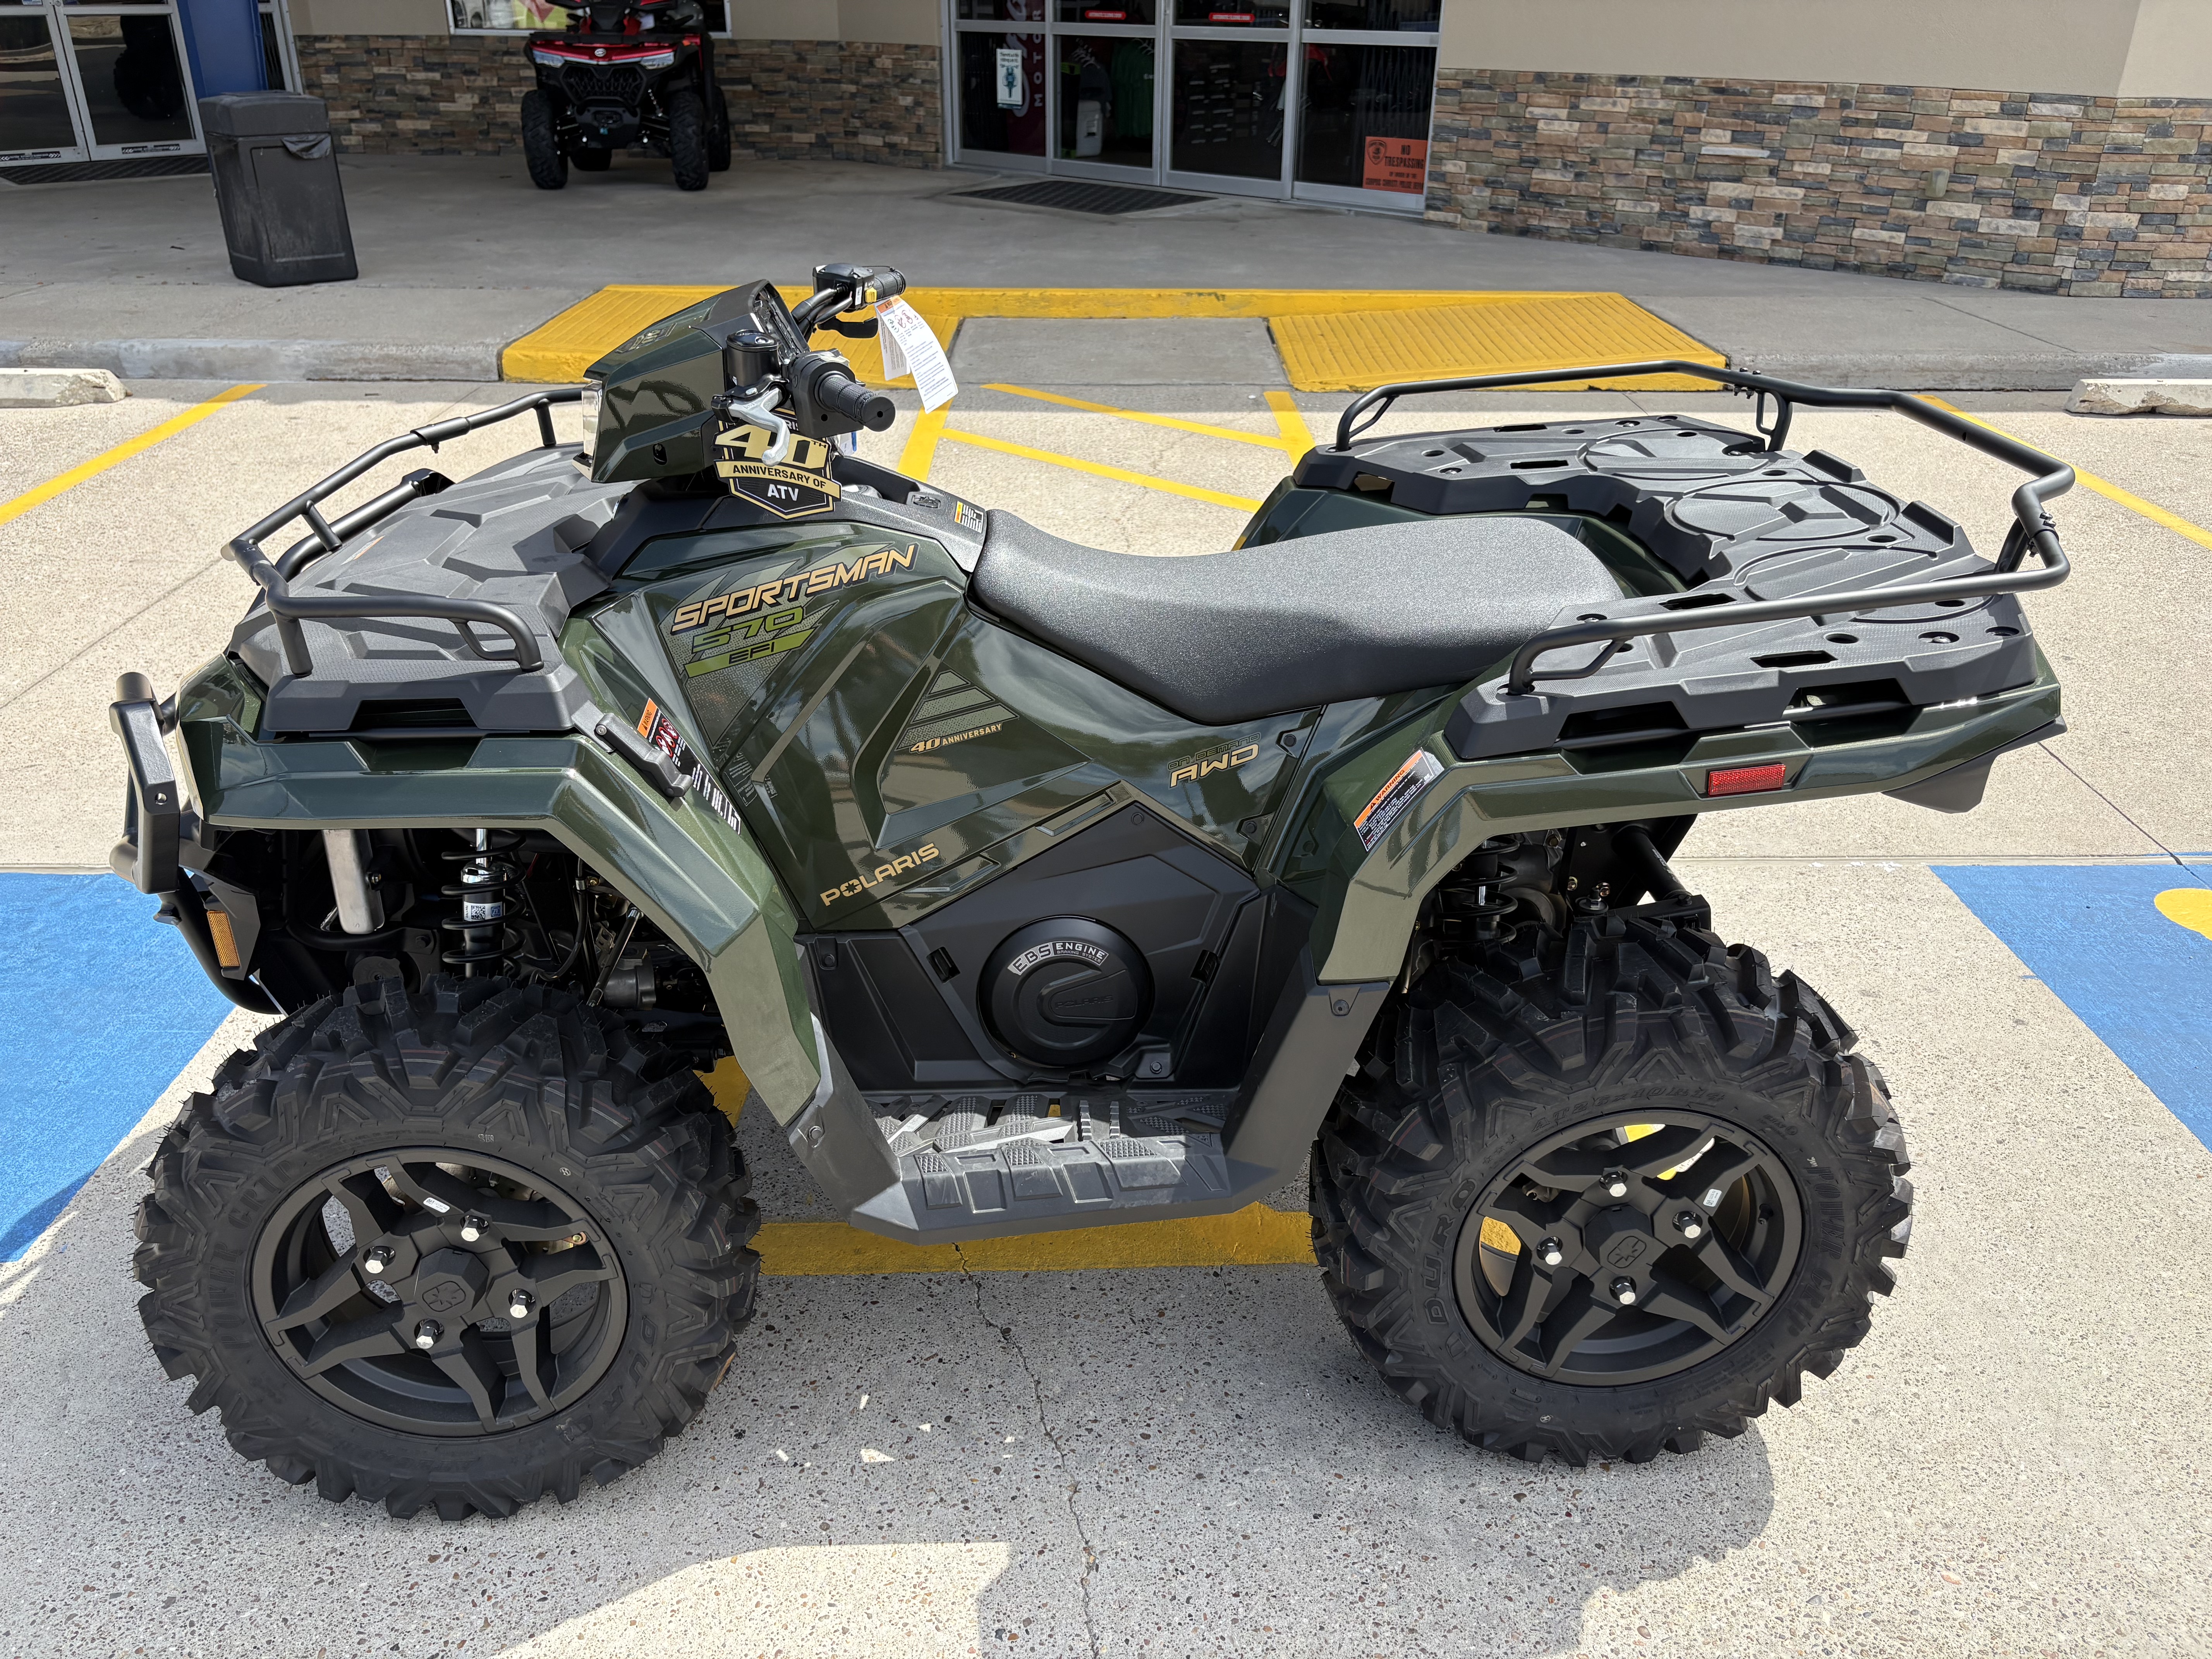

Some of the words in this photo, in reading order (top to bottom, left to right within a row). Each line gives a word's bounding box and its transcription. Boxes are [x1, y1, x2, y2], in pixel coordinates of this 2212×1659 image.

[1385, 156, 1424, 169] TRESPASSING
[733, 465, 810, 484] ANNIVERSARY
[813, 479, 826, 489] OF
[767, 484, 799, 501] ATV
[672, 544, 917, 633] SPORTSMAN
[692, 608, 804, 653] 570
[729, 641, 775, 665] EFI
[644, 709, 653, 725] WARNING
[942, 723, 1003, 746] ANNIVERSARY
[1196, 733, 1260, 759] DEMAND
[1170, 743, 1259, 788] AWD
[1376, 769, 1405, 801] WARNING
[819, 842, 940, 907] POLARIS
[1012, 944, 1052, 973] EBS
[1056, 943, 1105, 959] ENGINE
[1082, 953, 1101, 963] SYSTEM
[1055, 994, 1114, 1009] POLARIS
[1805, 1166, 1845, 1260] POWER
[1424, 1178, 1478, 1325] DURO
